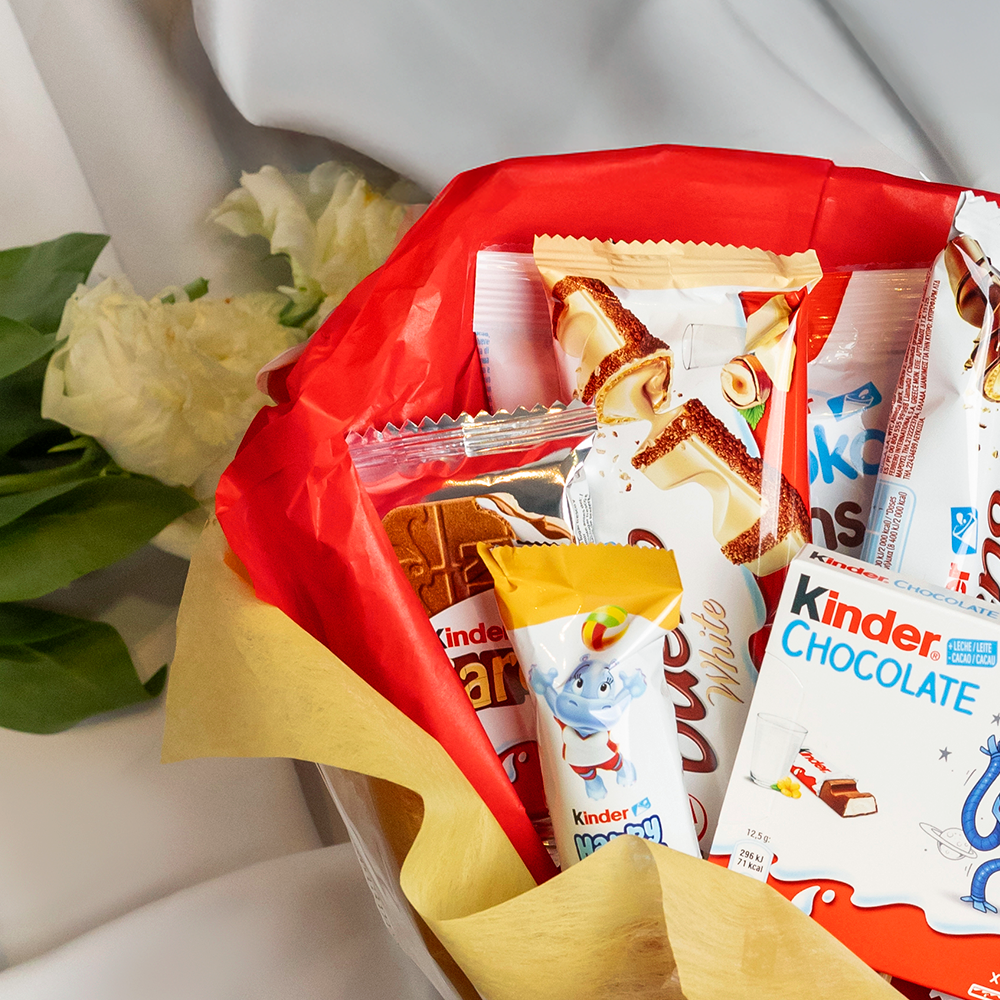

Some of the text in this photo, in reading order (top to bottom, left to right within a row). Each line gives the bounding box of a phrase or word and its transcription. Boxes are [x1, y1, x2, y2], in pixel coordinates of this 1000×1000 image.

[790, 573, 942, 657] Kinder
[809, 551, 999, 620] Kinder CHOCOLATE
[691, 598, 744, 706] White
[782, 619, 981, 716] CHOCOLATE
[572, 809, 629, 825] Kinder
[736, 857, 763, 872] 71 kcal
[739, 848, 754, 860] 296
